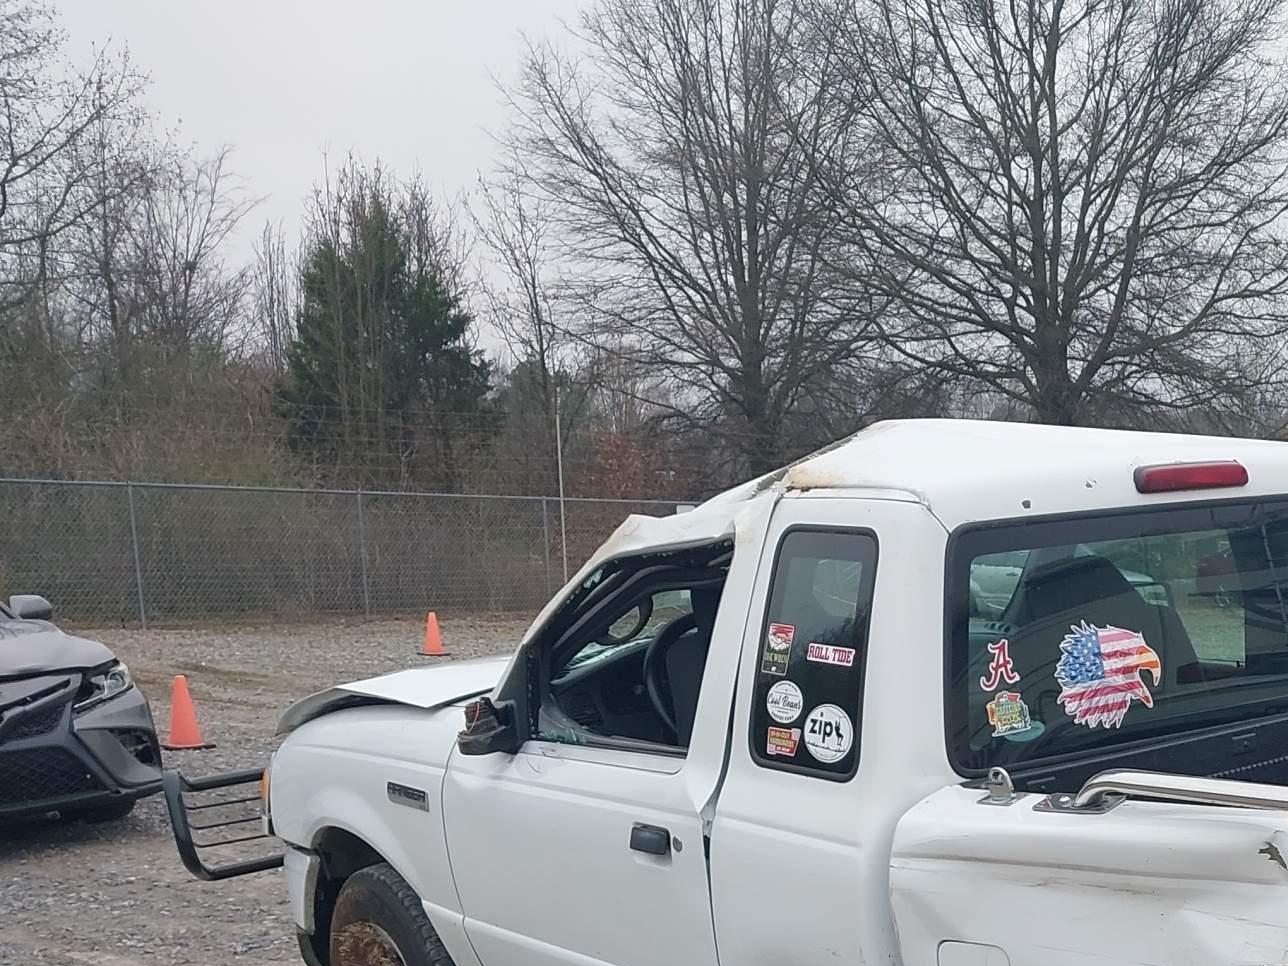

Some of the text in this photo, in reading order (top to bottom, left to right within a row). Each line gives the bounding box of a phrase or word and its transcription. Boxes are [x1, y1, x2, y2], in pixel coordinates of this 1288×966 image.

[808, 645, 854, 664] ROLL TIDE
[980, 639, 1020, 691] A
[808, 711, 834, 744] zip
